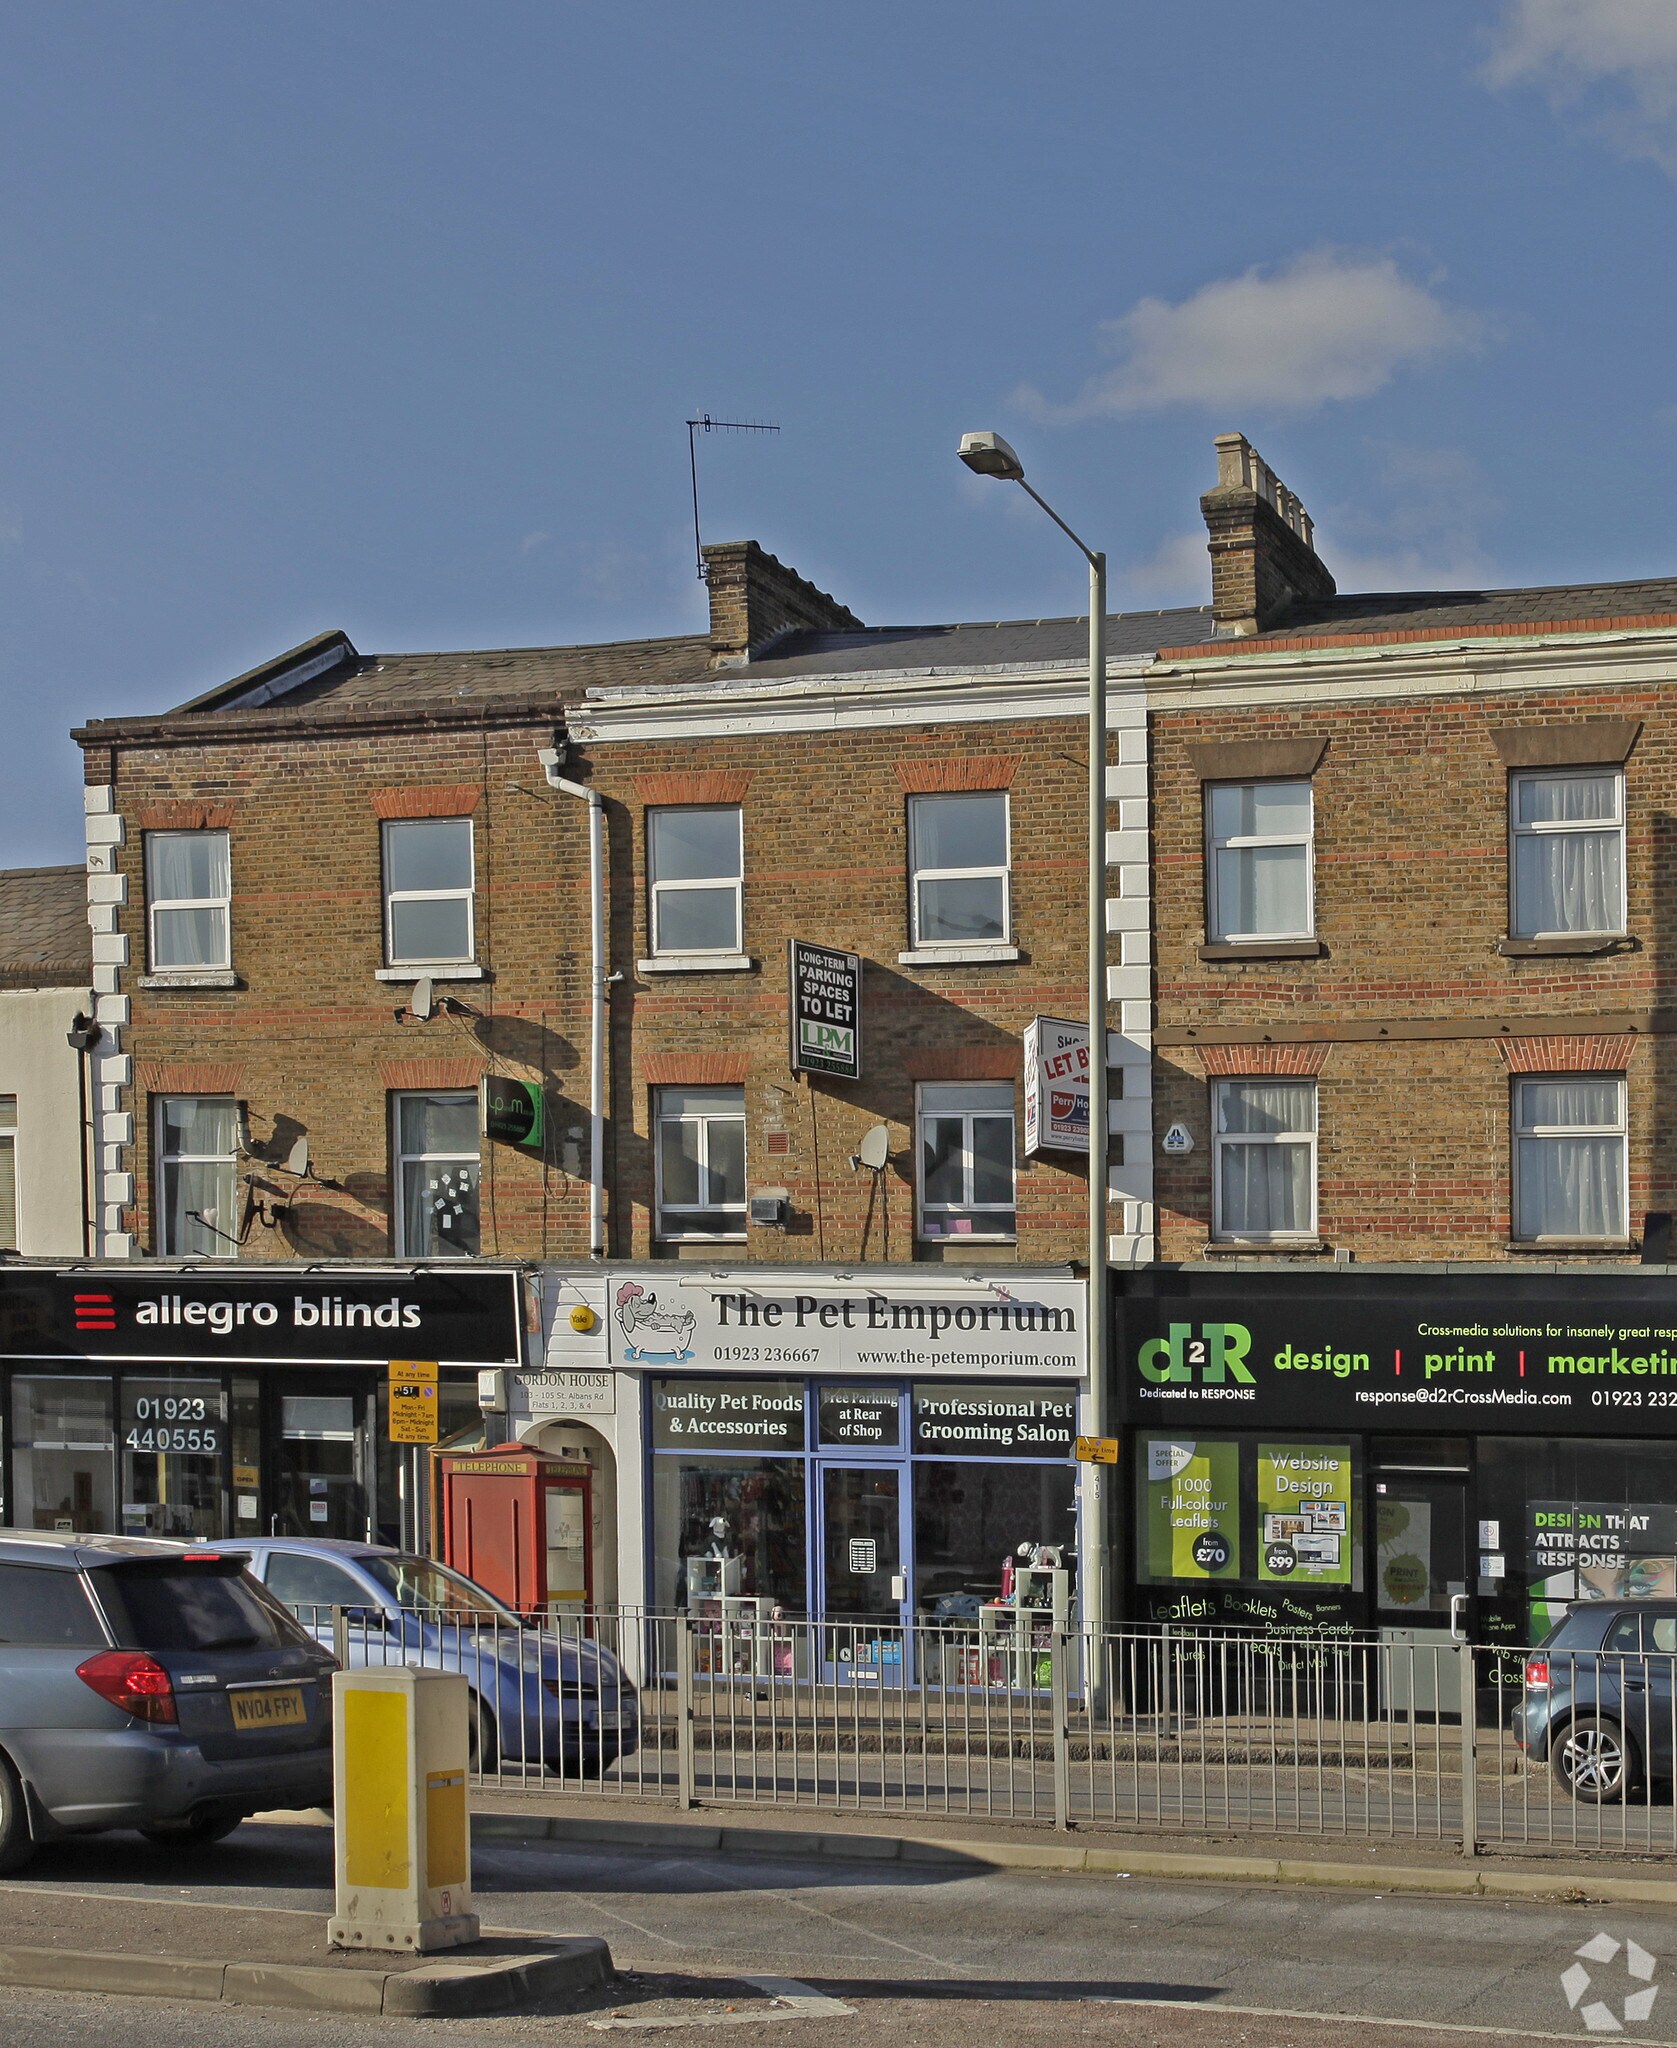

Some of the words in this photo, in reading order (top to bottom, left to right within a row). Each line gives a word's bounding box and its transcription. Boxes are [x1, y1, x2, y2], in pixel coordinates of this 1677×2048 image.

[800, 951, 845, 971] LONG-TERM
[800, 965, 853, 987] PARKING
[804, 982, 849, 1002] SPACES
[801, 995, 821, 1015] TO
[826, 1001, 852, 1022] LET
[802, 1022, 851, 1053] LPM
[1057, 1036, 1084, 1048] SH
[1044, 1052, 1073, 1080] LET
[1053, 1094, 1076, 1106] Perry
[1077, 1098, 1089, 1108] Ho
[136, 1295, 278, 1334] allegro
[294, 1296, 421, 1328] blinds
[571, 1315, 587, 1323] Yale
[711, 1293, 783, 1327] The
[795, 1295, 856, 1328] Pet
[867, 1296, 1077, 1339] Emporium
[1418, 1324, 1489, 1337] Cross-media
[1492, 1325, 1543, 1337] solutions
[1546, 1324, 1563, 1337] for
[1567, 1325, 1615, 1341] insanely
[1619, 1326, 1651, 1341] great
[714, 1346, 760, 1361] 01923
[764, 1347, 820, 1362] 236667
[857, 1349, 1077, 1368] www.the-petemporium.com
[1274, 1344, 1370, 1378] design
[1425, 1346, 1496, 1379] print
[514, 1372, 566, 1387] GORDON
[569, 1374, 608, 1387] HOUSE
[569, 1392, 592, 1400] Albans
[655, 1392, 716, 1413] Quality
[720, 1394, 748, 1411] Pet
[752, 1394, 803, 1412] Foods
[852, 1392, 898, 1407] Parking
[1140, 1388, 1187, 1399] Dedicated
[1189, 1389, 1199, 1399] to
[1201, 1389, 1256, 1400] RESPONSE
[1355, 1389, 1572, 1406] response@d2rCrossMedia.com
[1591, 1391, 1642, 1406] 01923
[136, 1397, 206, 1421] 01923
[839, 1408, 851, 1420] at
[853, 1409, 882, 1420] Rear
[918, 1398, 1035, 1417] Professional
[1040, 1400, 1073, 1418] Pet
[669, 1417, 683, 1433] &
[687, 1419, 787, 1436] Accessories
[839, 1424, 851, 1436] of
[853, 1424, 882, 1439] Shop
[919, 1421, 1013, 1445] Grooming
[1017, 1424, 1070, 1442] Salon
[126, 1427, 217, 1451] 440555
[1155, 1450, 1185, 1458] SPECIAL
[1270, 1452, 1340, 1471] Website
[457, 1461, 522, 1473] TELEPHONE
[1155, 1459, 1179, 1467] OFFER
[1176, 1478, 1213, 1493] 1000
[1276, 1475, 1334, 1499] Design
[1161, 1495, 1228, 1511] Full-colour
[1169, 1512, 1219, 1528] Leaflets
[1535, 1512, 1601, 1529] DESIGN
[1605, 1514, 1650, 1531] THAT
[1202, 1537, 1219, 1546] from
[1535, 1533, 1620, 1550] ATTRACTS
[1196, 1549, 1225, 1562] £70
[1273, 1547, 1288, 1555] from
[1268, 1557, 1294, 1569] £99
[1537, 1552, 1626, 1570] RESPONSE
[1390, 1566, 1419, 1577] PRINT
[1150, 1595, 1216, 1620] Leaflets
[1224, 1594, 1278, 1619] Booklets
[1282, 1598, 1313, 1620] Posters
[1316, 1604, 1341, 1612] Banners
[1265, 1621, 1314, 1635] Business
[1318, 1620, 1355, 1635] Cards
[275, 1697, 299, 1718] FPY
